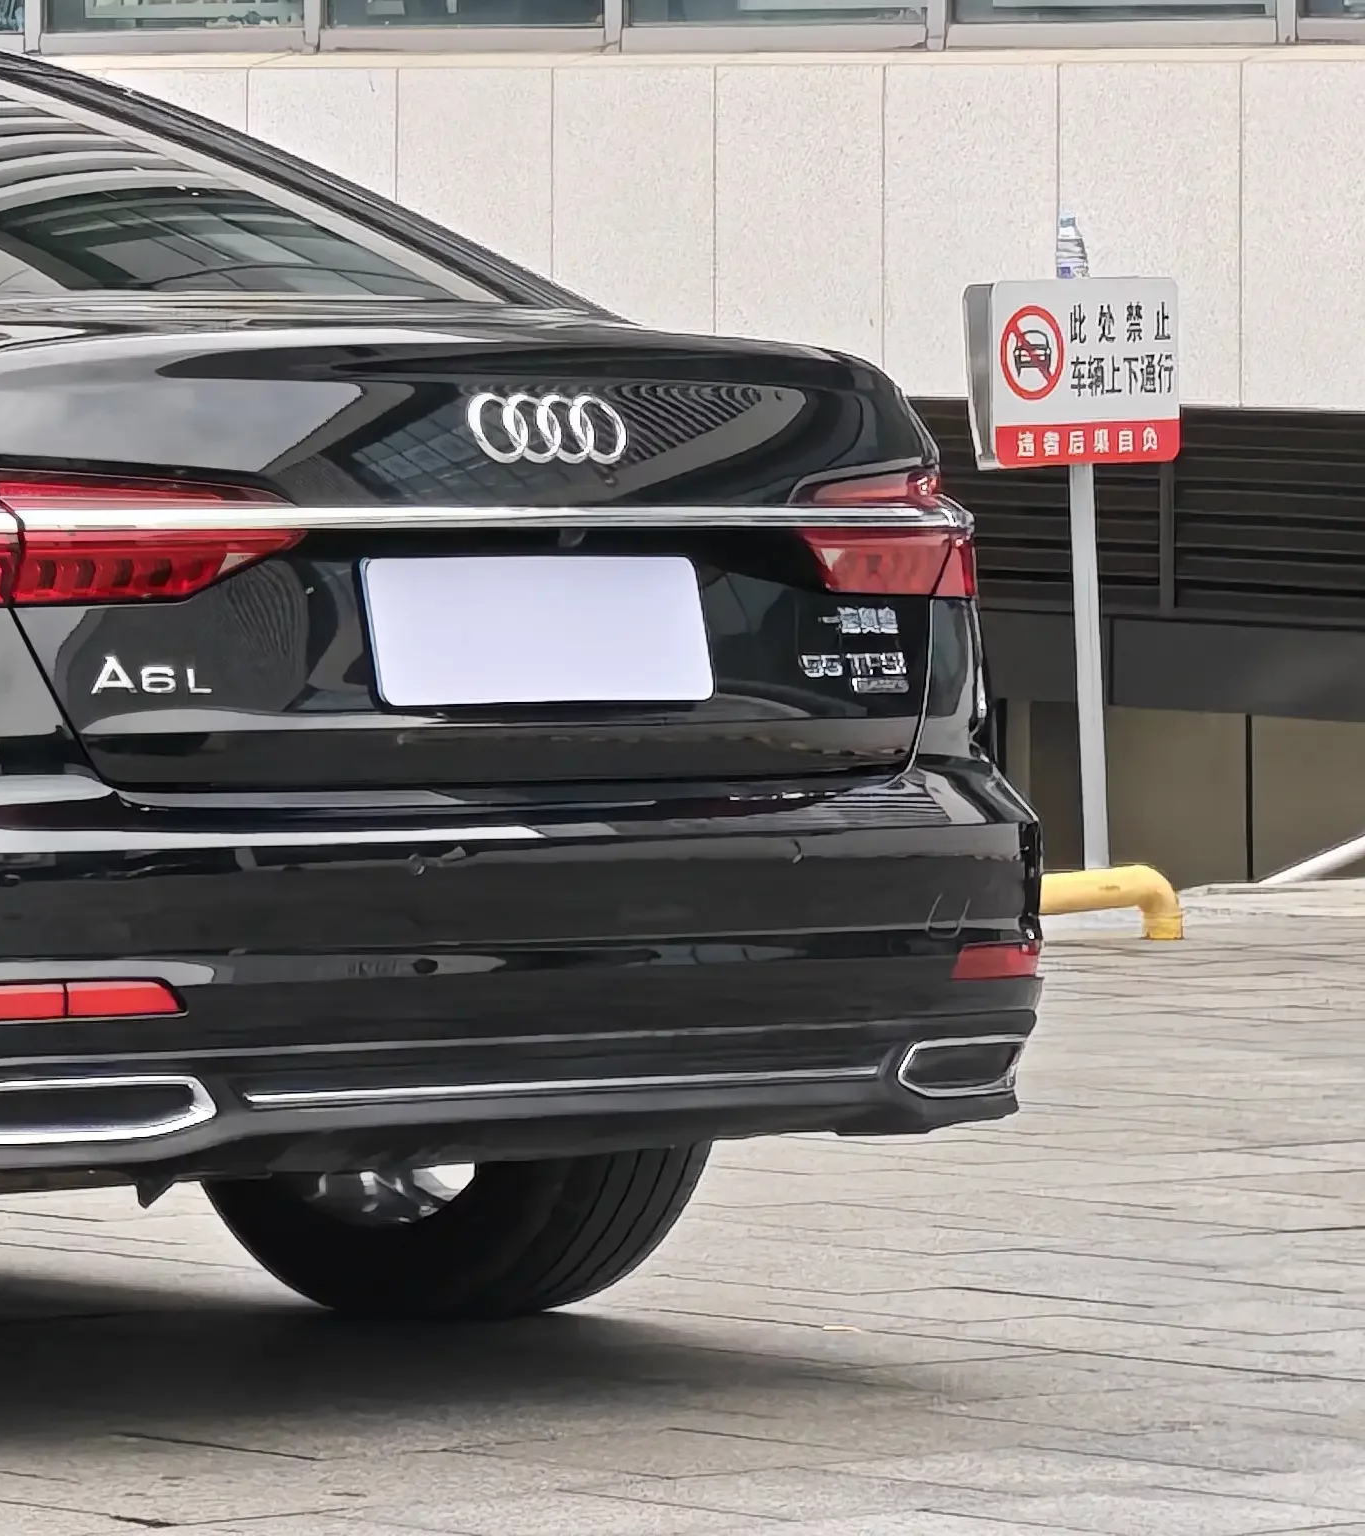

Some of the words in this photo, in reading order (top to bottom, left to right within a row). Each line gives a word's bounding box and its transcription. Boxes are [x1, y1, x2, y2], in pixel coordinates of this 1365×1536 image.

[1069, 301, 1172, 344] 此处禁止
[1070, 353, 1174, 397] 车辆上下通行
[90, 655, 213, 695] A6L
